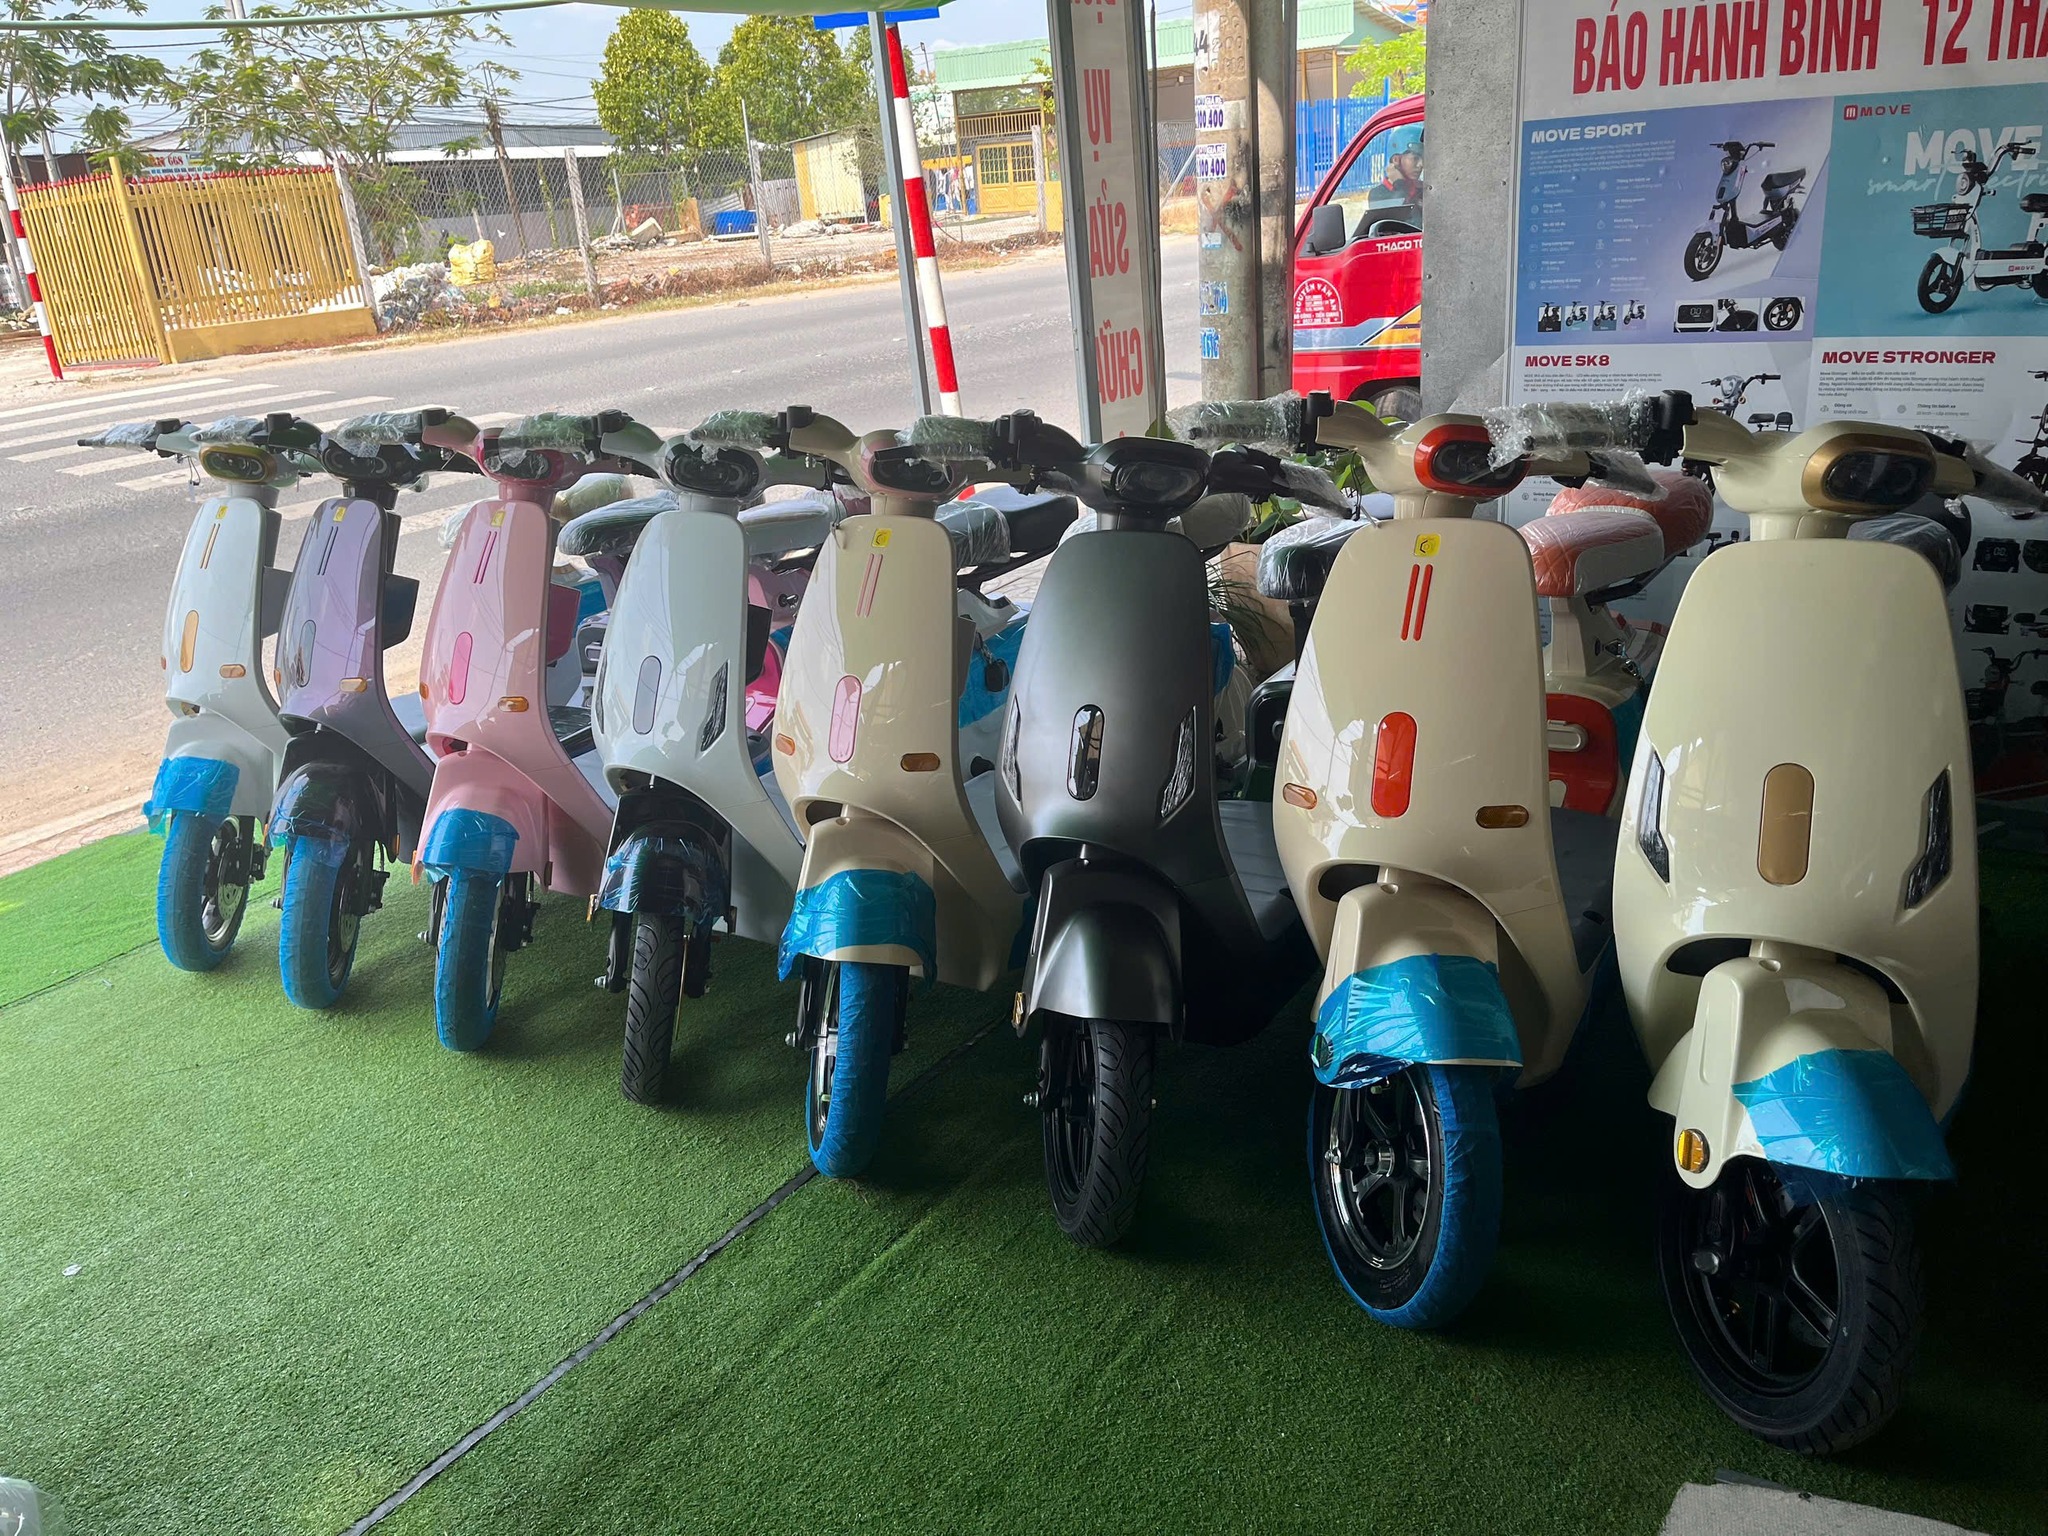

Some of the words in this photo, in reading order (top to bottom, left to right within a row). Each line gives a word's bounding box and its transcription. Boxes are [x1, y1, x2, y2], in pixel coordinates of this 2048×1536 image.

[1923, 0, 1973, 65] 12
[1860, 104, 1911, 117] MOVE
[1531, 127, 1581, 144] MOVE
[1584, 122, 1646, 139] SPORT
[1904, 125, 2043, 175] MOVE
[1376, 240, 1412, 252] THACO
[1525, 355, 1572, 367] MOVE
[1575, 355, 1610, 367] SK8
[1822, 351, 1879, 364] MOVE
[1882, 350, 1996, 364] STRONGER
